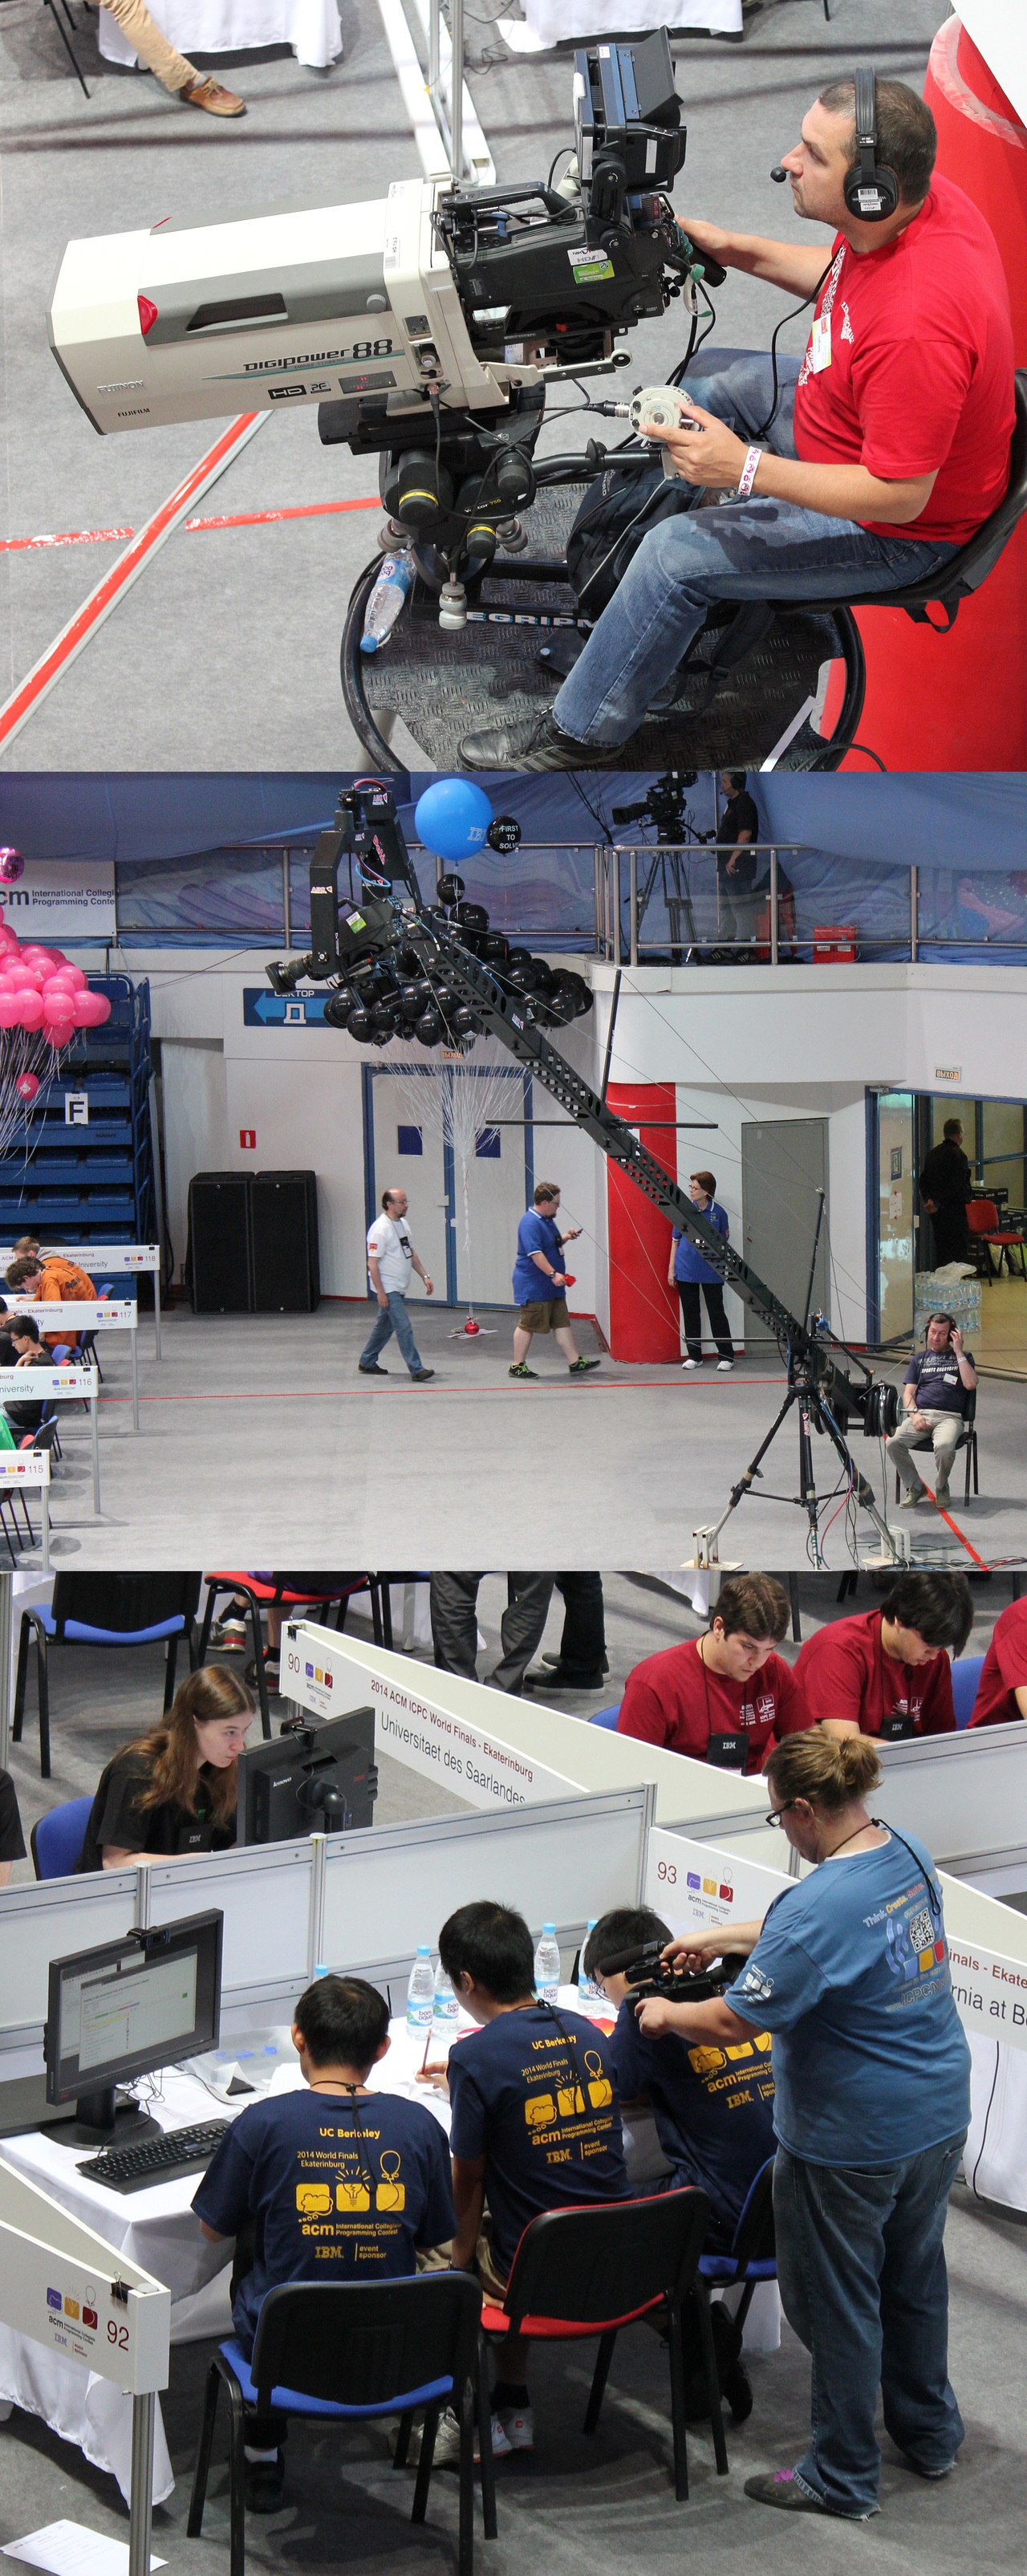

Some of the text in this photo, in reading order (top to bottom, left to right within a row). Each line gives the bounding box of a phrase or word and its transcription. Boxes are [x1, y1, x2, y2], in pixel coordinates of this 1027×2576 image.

[352, 339, 393, 360] 88
[97, 380, 144, 396] FUJINON
[273, 388, 303, 397] HD
[118, 408, 150, 417] FUJIFILM
[32, 889, 84, 897] International
[32, 898, 88, 908] Programming
[283, 1003, 306, 1024] Д
[936, 1070, 959, 1080] ВЫХОД
[69, 1101, 84, 1122] F
[79, 1378, 92, 1386] 116
[28, 1465, 43, 1473] 115
[288, 1653, 300, 1673] 90
[371, 1680, 388, 1697] 2014
[390, 1690, 408, 1709] ACM
[409, 1700, 428, 1720] ICPC
[429, 1711, 452, 1733] World
[453, 1725, 477, 1748] Finals
[483, 1742, 534, 1782] Ekaterinburg
[381, 1712, 441, 1761] Universitaet
[444, 1749, 462, 1774] des
[723, 1741, 737, 1749] IBM
[273, 1777, 292, 1788] lenovo
[189, 1834, 201, 1843] IBM
[657, 1862, 677, 1884] 93
[688, 1894, 702, 1904] acm
[989, 1999, 1005, 2019] at
[531, 2041, 545, 2050] UC
[521, 2058, 569, 2077] 2014 World Finals
[526, 2069, 561, 2084] Ekaterinburg
[707, 2074, 737, 2093] acm
[735, 2063, 764, 2077] International
[737, 2070, 768, 2082] Programming
[319, 2128, 335, 2138] UC
[532, 2131, 561, 2146] acm
[561, 2121, 594, 2133] International
[562, 2127, 596, 2140] Programming
[584, 2140, 600, 2150] event
[584, 2144, 608, 2157] sponsor
[315, 2151, 337, 2160] World
[338, 2151, 359, 2160] Finals
[300, 2160, 345, 2169] Ekaterinburg
[302, 2224, 335, 2236] acm
[335, 2229, 377, 2237] Programming
[359, 2252, 387, 2260] sponsor
[49, 2315, 63, 2329] acm
[107, 2320, 129, 2352] 92
